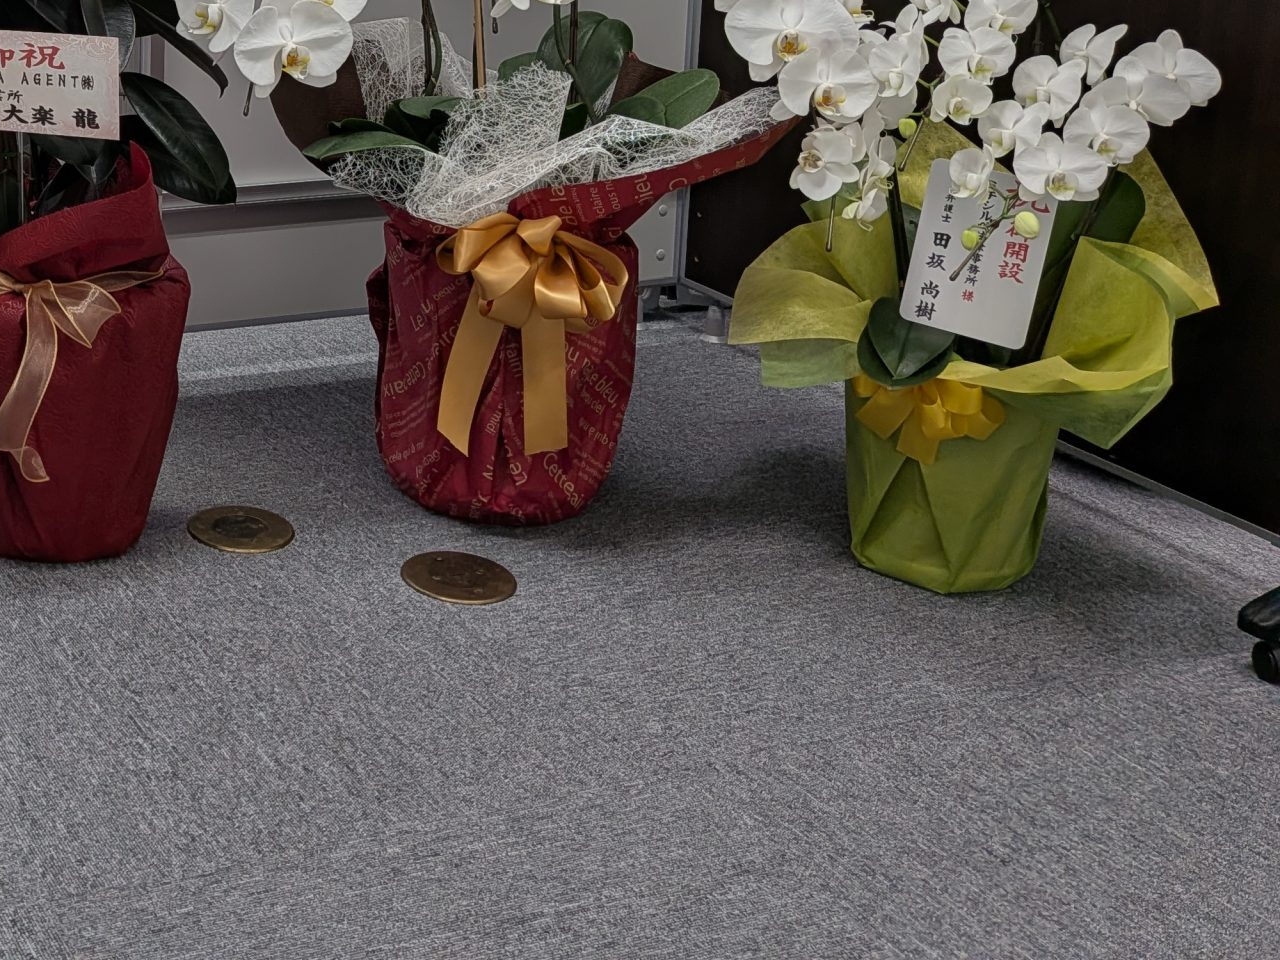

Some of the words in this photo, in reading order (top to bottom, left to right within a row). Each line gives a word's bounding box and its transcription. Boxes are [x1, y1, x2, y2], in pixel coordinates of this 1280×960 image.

[0, 103, 57, 126] 大楽
[72, 108, 100, 130] 龍
[925, 231, 952, 272] 田坂
[914, 280, 940, 321] 尚樹
